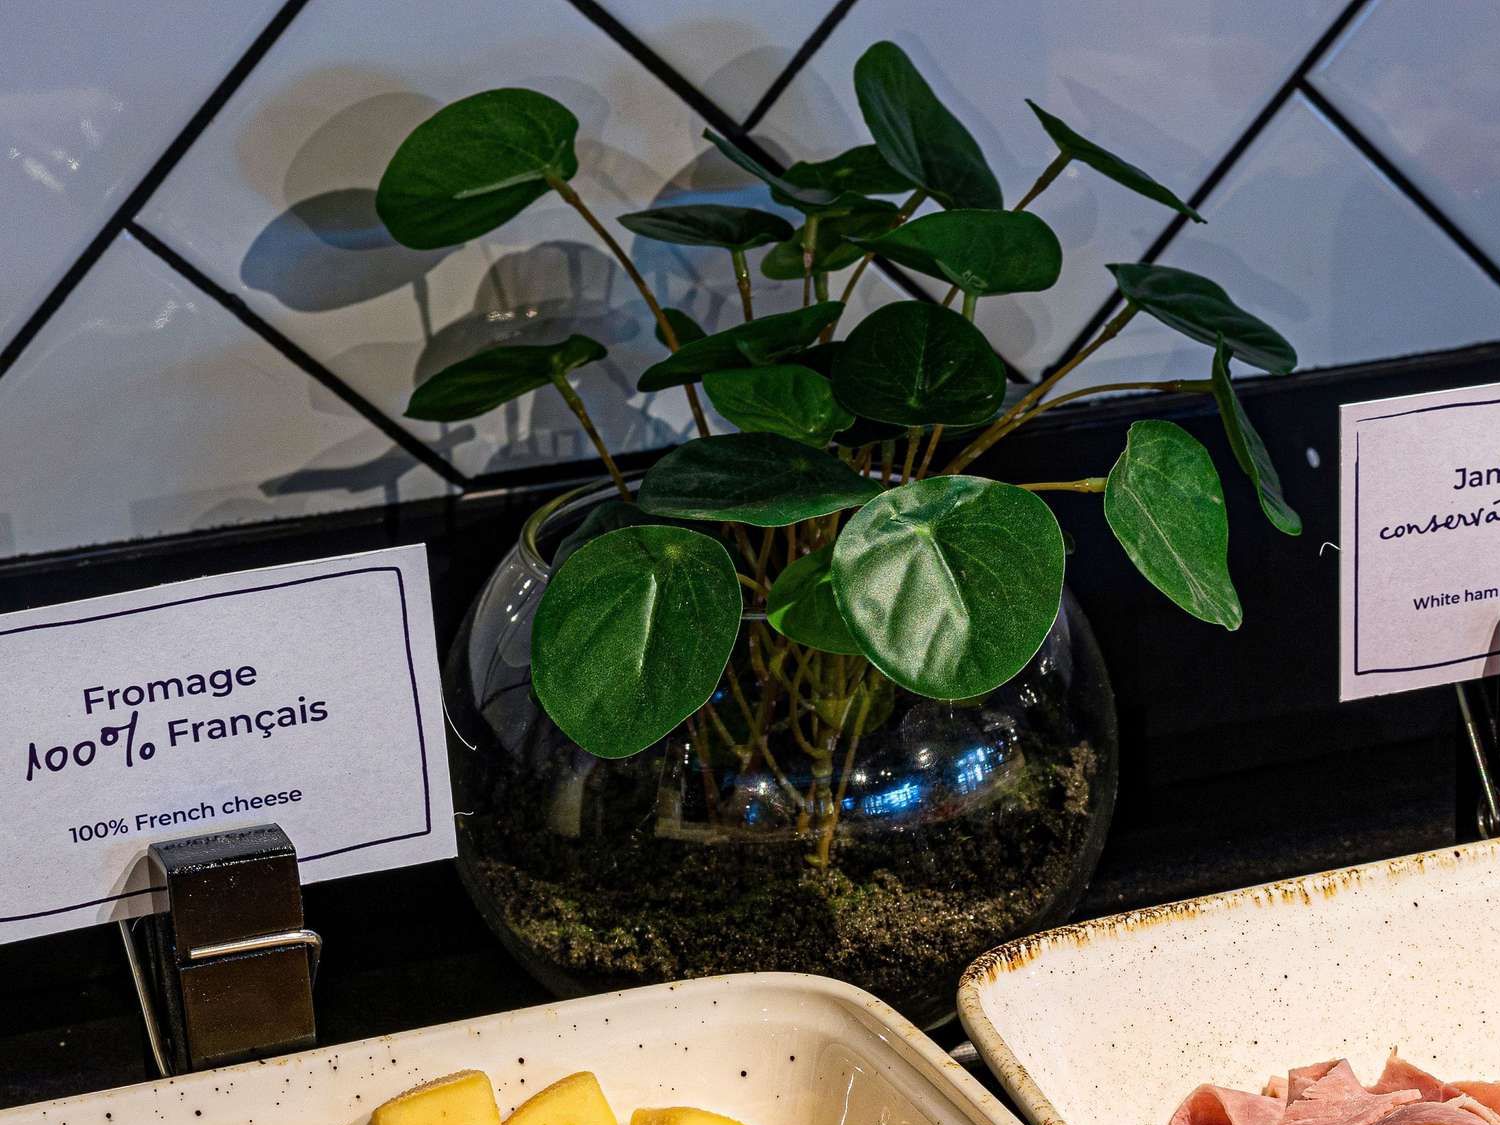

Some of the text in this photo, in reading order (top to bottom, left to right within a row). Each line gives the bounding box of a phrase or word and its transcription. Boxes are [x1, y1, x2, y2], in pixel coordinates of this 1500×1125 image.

[1413, 593, 1461, 611] White
[1464, 587, 1499, 603] ham
[83, 665, 257, 715] Fromage
[26, 695, 329, 782] 100% Français
[68, 789, 303, 844] 100% French cheese
